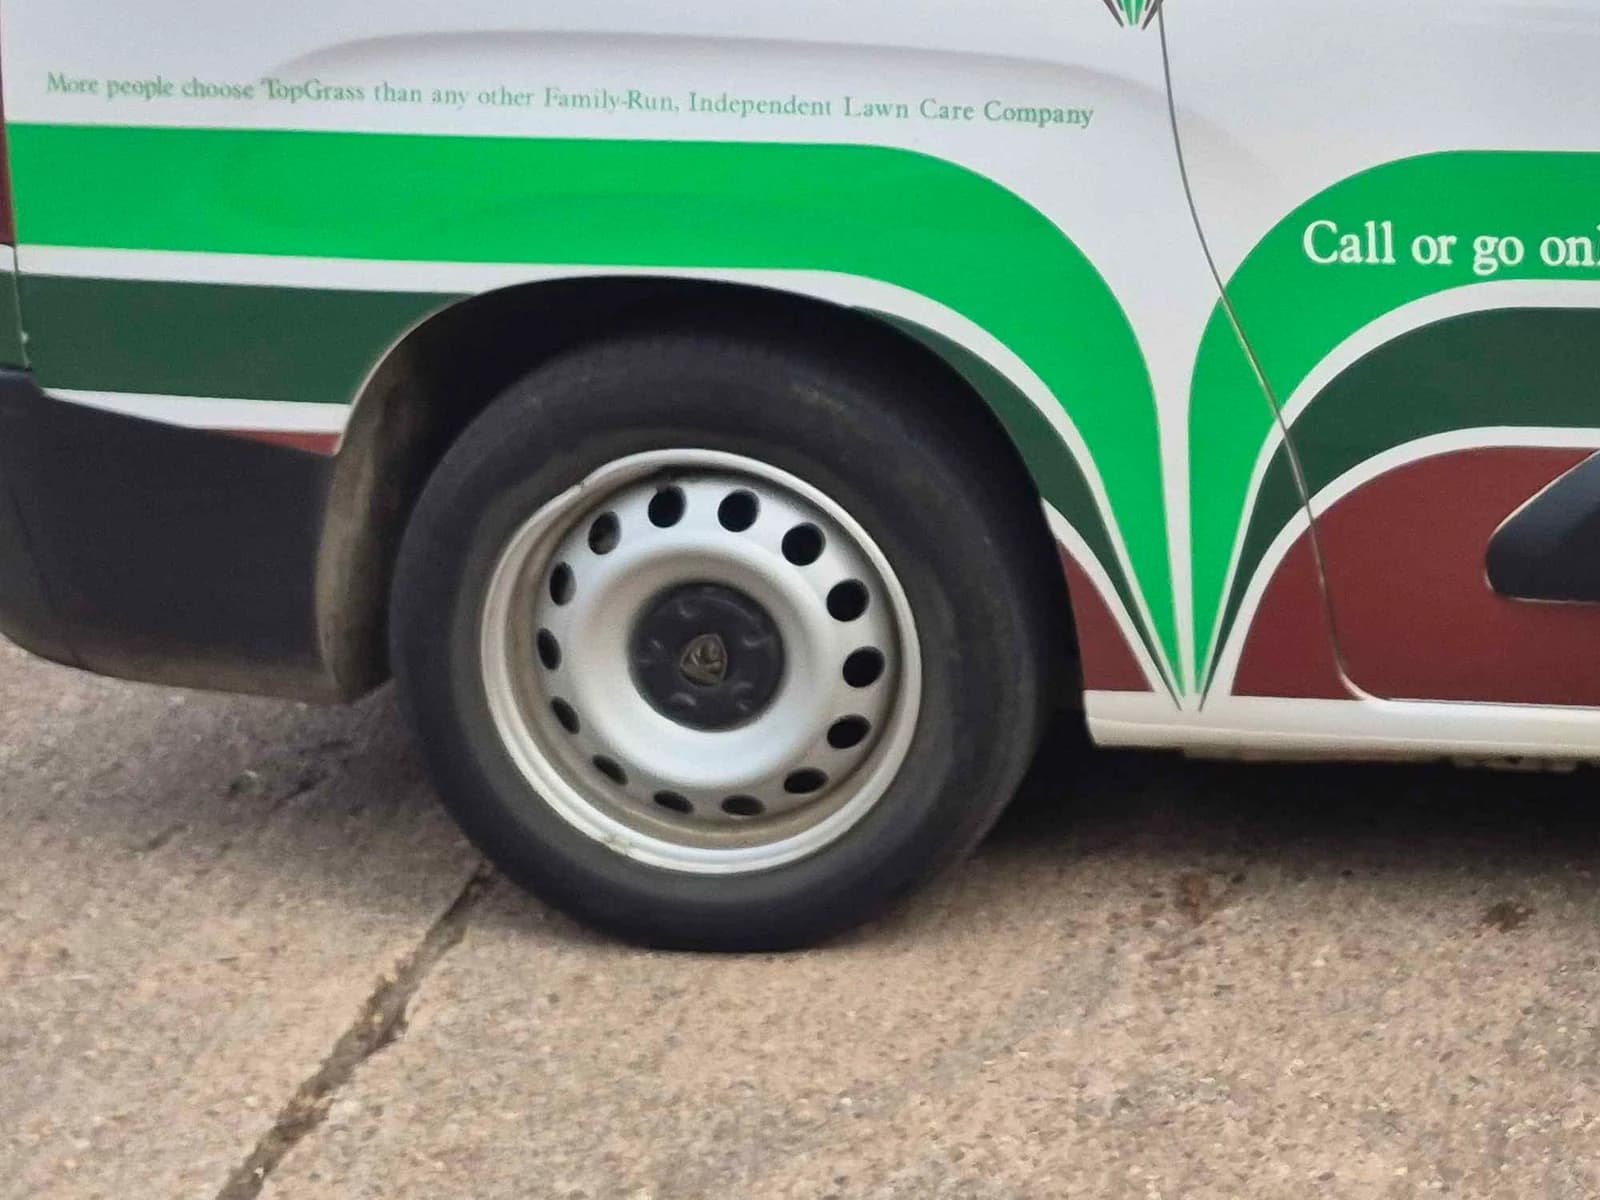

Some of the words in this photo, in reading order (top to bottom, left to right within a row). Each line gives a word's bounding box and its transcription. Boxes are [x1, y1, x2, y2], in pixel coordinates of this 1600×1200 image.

[46, 71, 99, 96] More
[106, 75, 175, 102] people
[181, 76, 255, 101] choose
[260, 77, 366, 105] TopGrass
[374, 80, 423, 105] than
[431, 87, 469, 110] any
[477, 84, 535, 107] other
[544, 86, 680, 114] Family-Run,
[688, 90, 832, 119] Independent
[843, 96, 909, 120] Lawn
[920, 97, 975, 122] Care
[983, 99, 1095, 129] Company
[1303, 220, 1396, 264] Call
[1411, 234, 1457, 265] or
[1473, 235, 1524, 275] go
